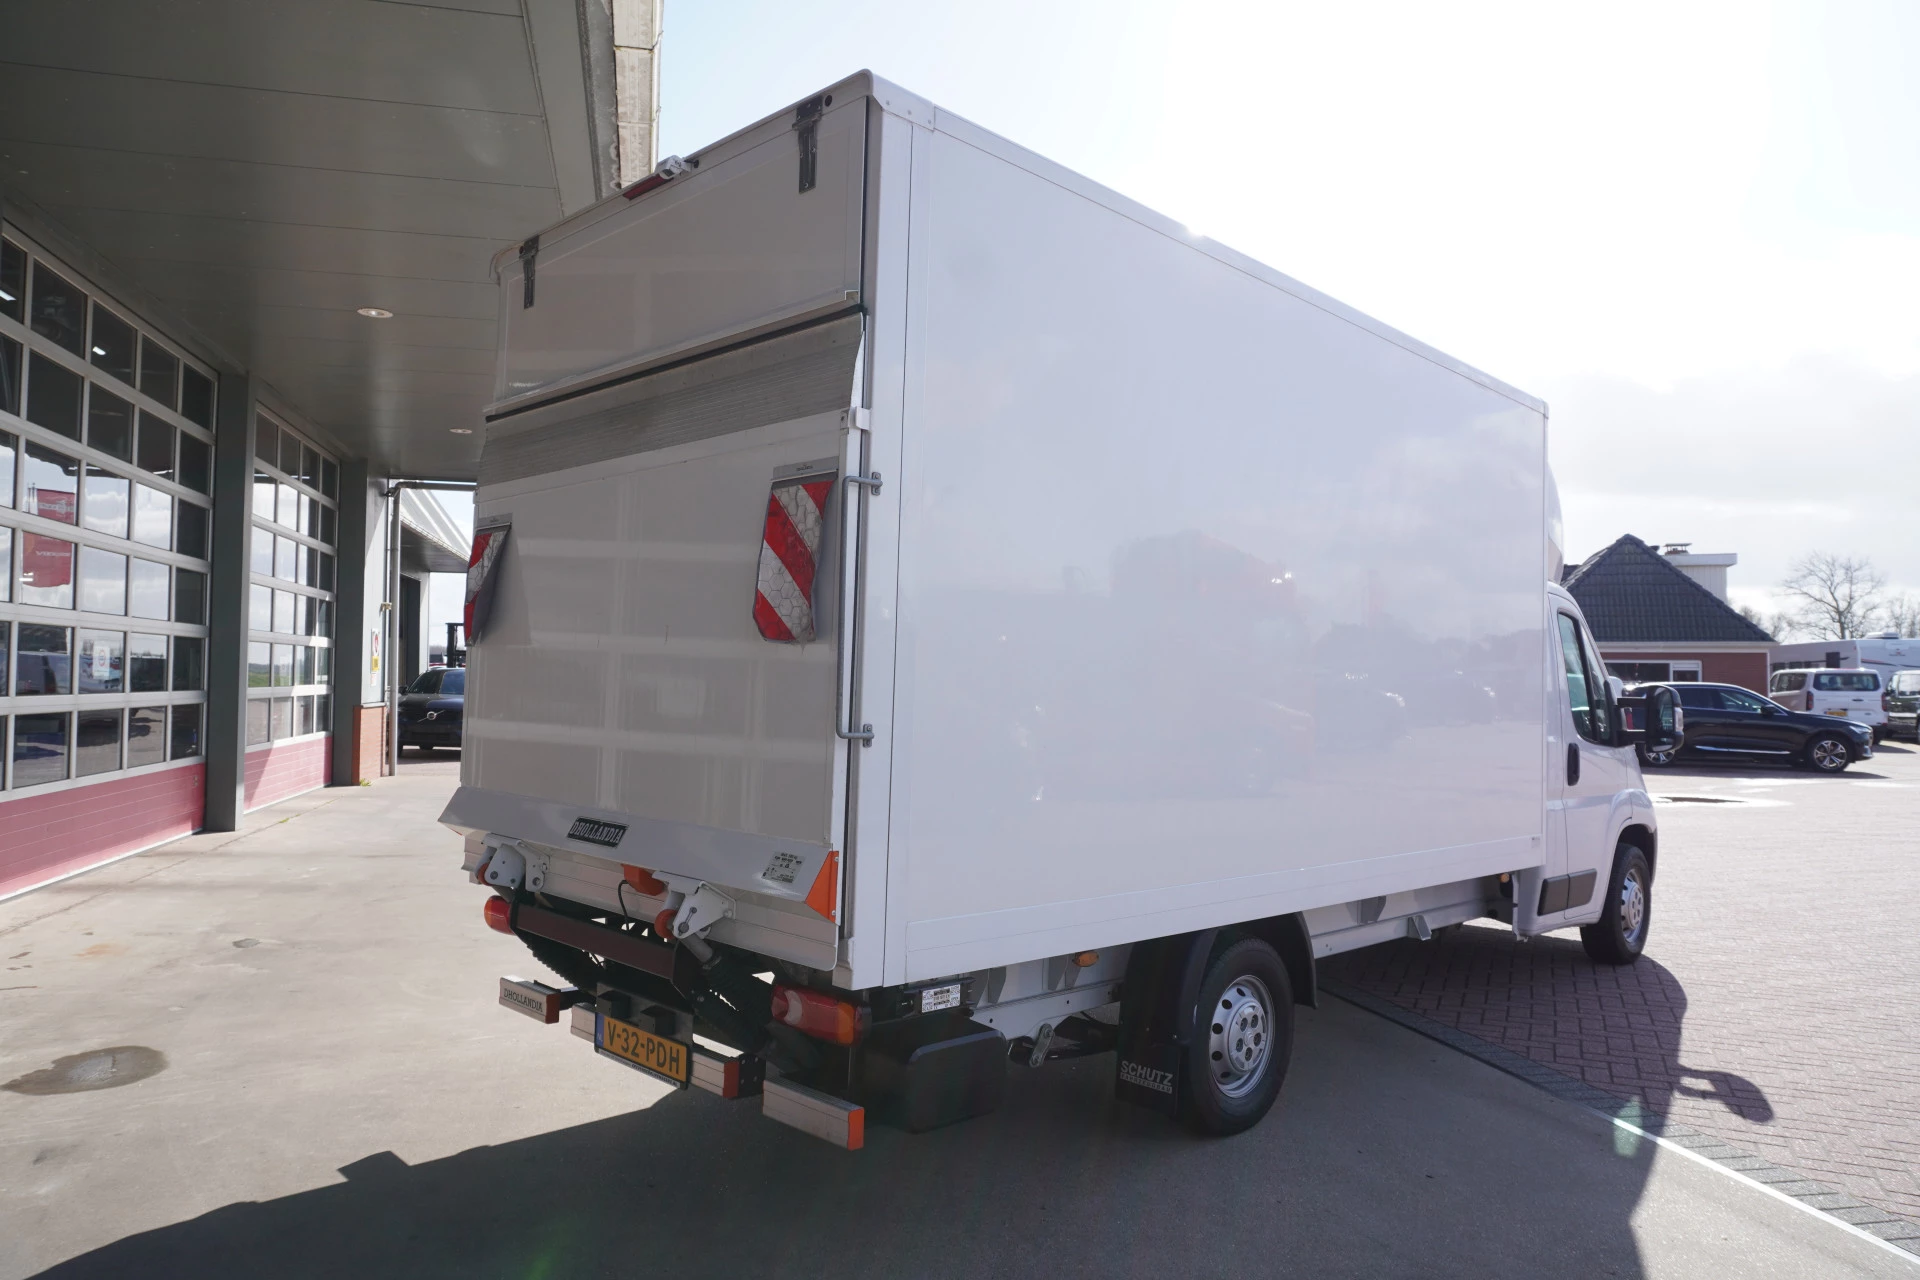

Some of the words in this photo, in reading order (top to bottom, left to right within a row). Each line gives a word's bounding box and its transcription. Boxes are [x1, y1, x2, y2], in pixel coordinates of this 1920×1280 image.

[569, 821, 624, 843] DHOLLANDIA
[503, 988, 543, 1012] DHOLLANDIA
[607, 1020, 679, 1075] V-32-PDH
[1120, 1060, 1174, 1086] SCHUTZ
